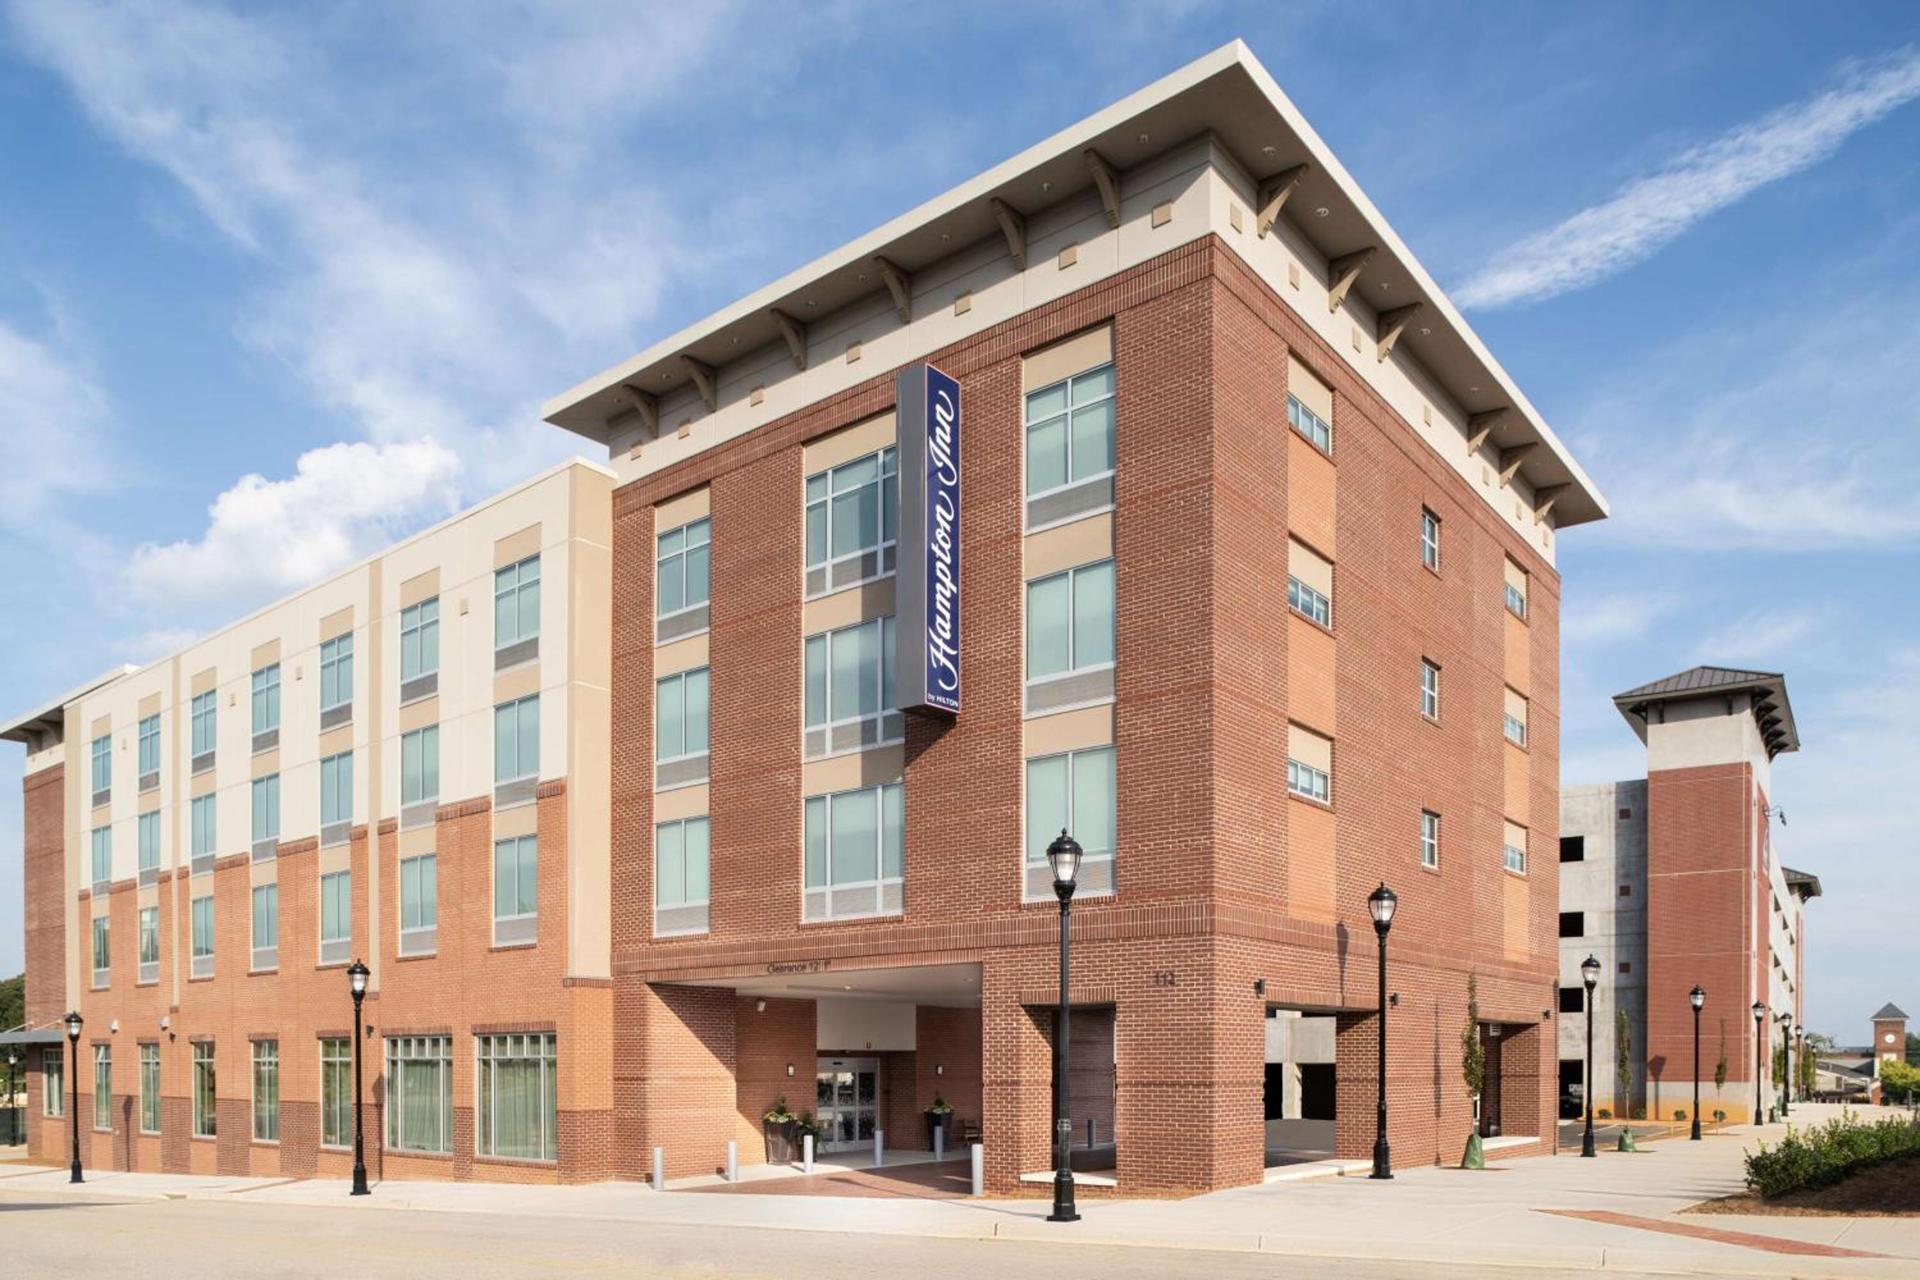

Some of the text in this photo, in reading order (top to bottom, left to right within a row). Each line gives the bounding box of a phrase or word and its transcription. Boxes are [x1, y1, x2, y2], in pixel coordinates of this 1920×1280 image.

[929, 389, 959, 691] Hampton Inn
[927, 693, 959, 707] by HILTON
[767, 962, 806, 975] Clearance
